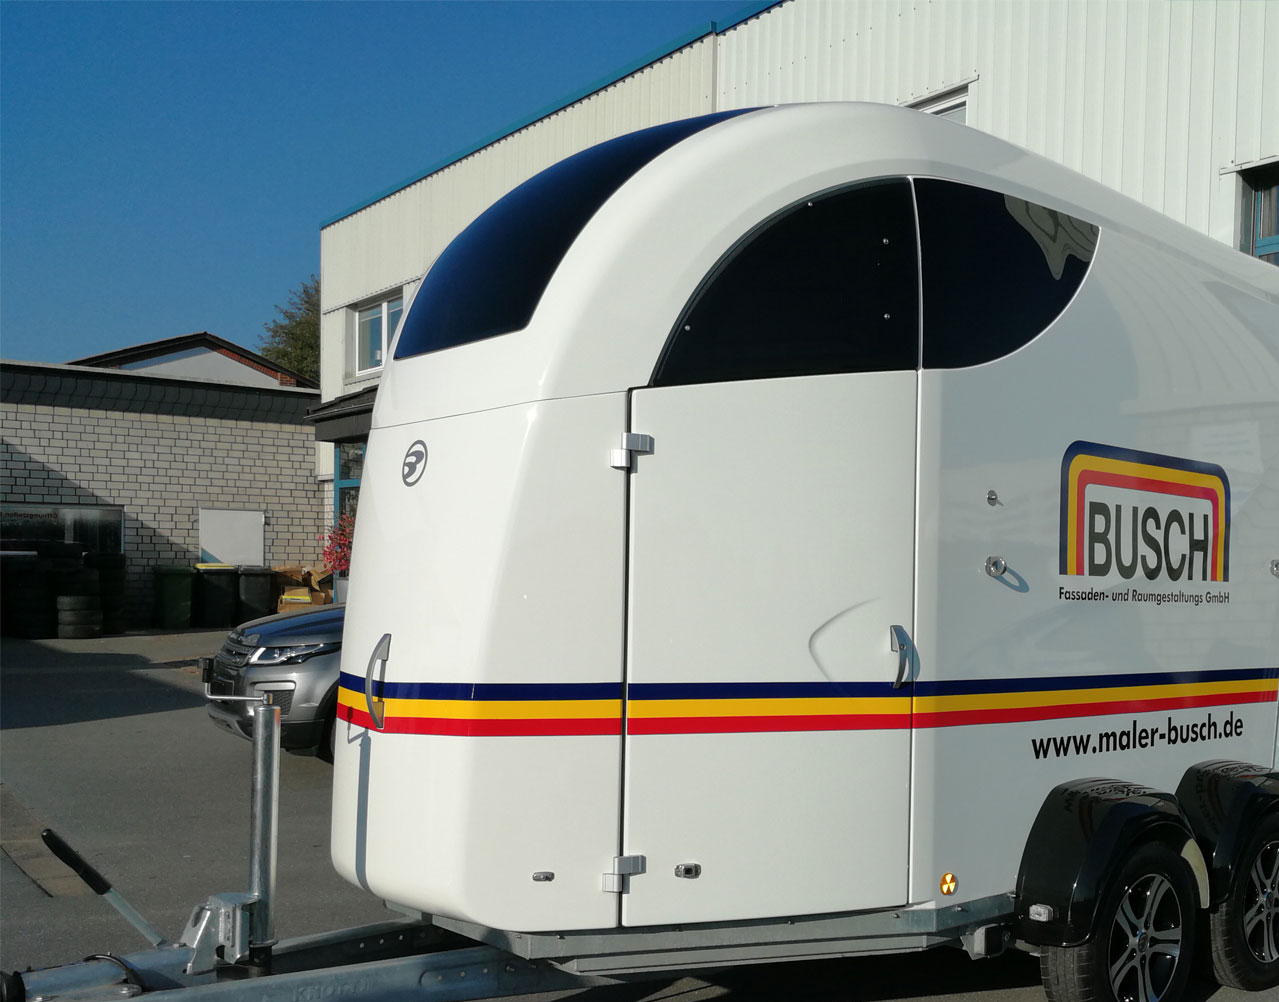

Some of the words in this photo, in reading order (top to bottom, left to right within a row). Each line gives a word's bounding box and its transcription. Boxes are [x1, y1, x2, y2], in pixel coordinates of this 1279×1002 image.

[1088, 501, 1209, 581] BUSCH
[1059, 586, 1109, 601] Fassaden-
[1111, 588, 1129, 602] und
[1132, 589, 1204, 606] Raumgestaltungs
[1205, 591, 1230, 604] GmbH
[1031, 710, 1244, 759] www.maler-busch.de
